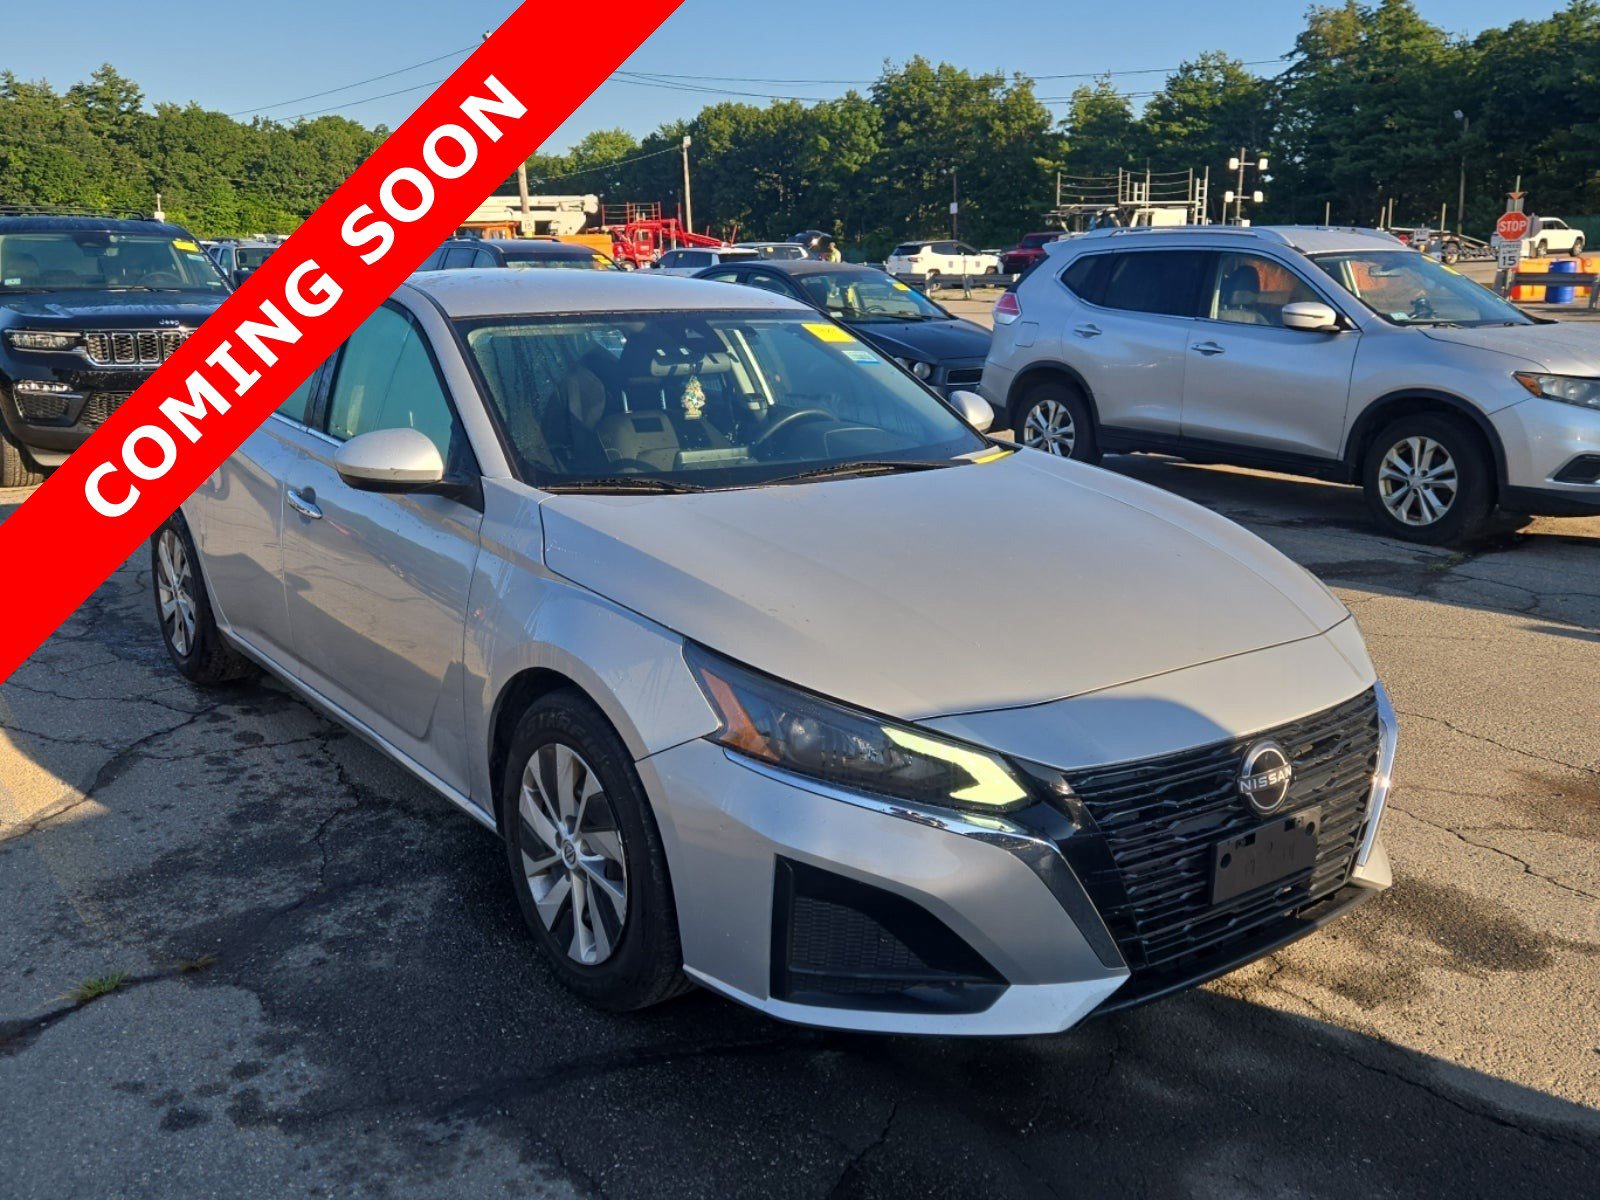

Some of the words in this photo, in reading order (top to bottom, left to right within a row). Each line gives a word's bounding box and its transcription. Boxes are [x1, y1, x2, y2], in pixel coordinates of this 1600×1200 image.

[1499, 220, 1527, 232] STOP
[1502, 255, 1517, 267] 15
[158, 318, 180, 326] Jeep
[1239, 764, 1292, 793] NISSAN
